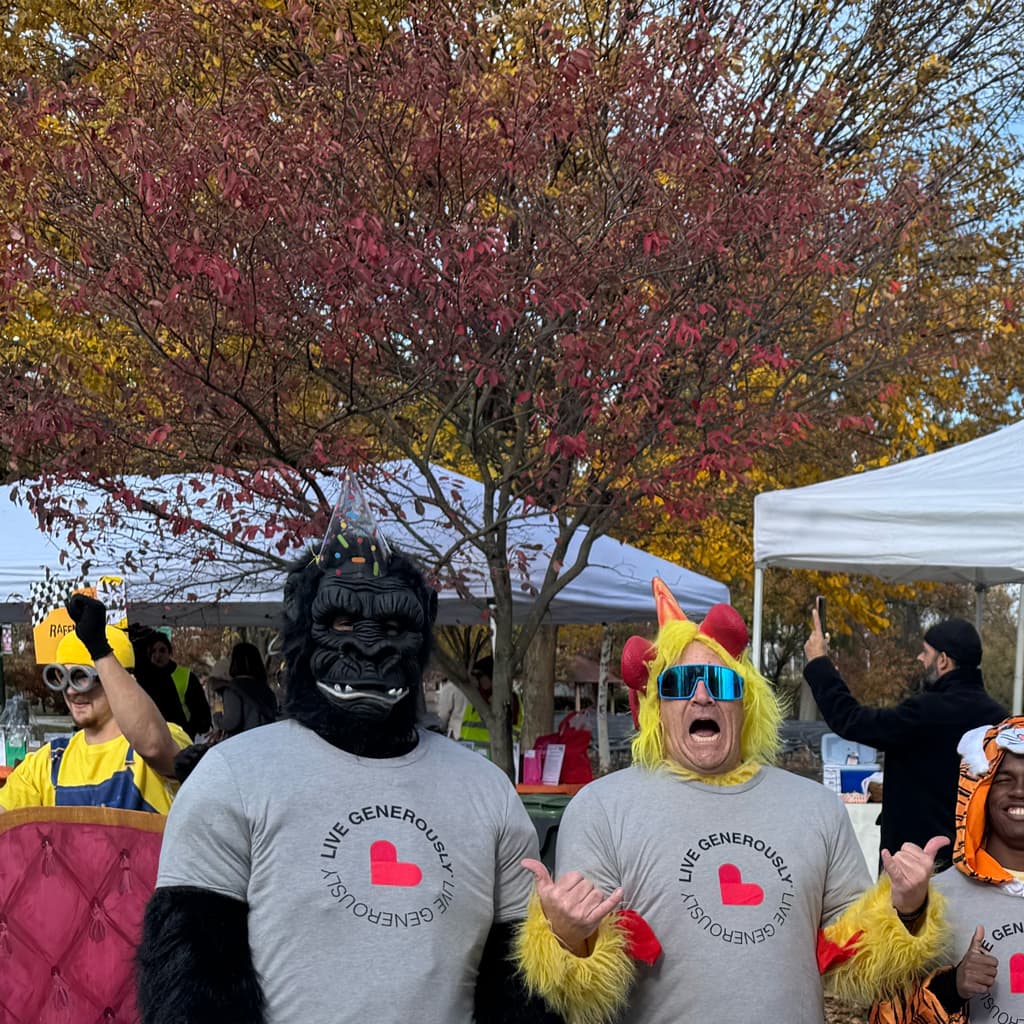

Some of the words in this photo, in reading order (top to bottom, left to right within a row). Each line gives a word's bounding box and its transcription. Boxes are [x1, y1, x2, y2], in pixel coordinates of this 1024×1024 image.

[49, 622, 76, 638] RAFF
[320, 822, 350, 859] LIVE
[678, 848, 701, 883] LIVE
[320, 868, 435, 928] GENEROUSLY
[433, 880, 455, 914] LIVE
[773, 892, 795, 926] LIVE
[680, 892, 776, 945] GENEROUSLY
